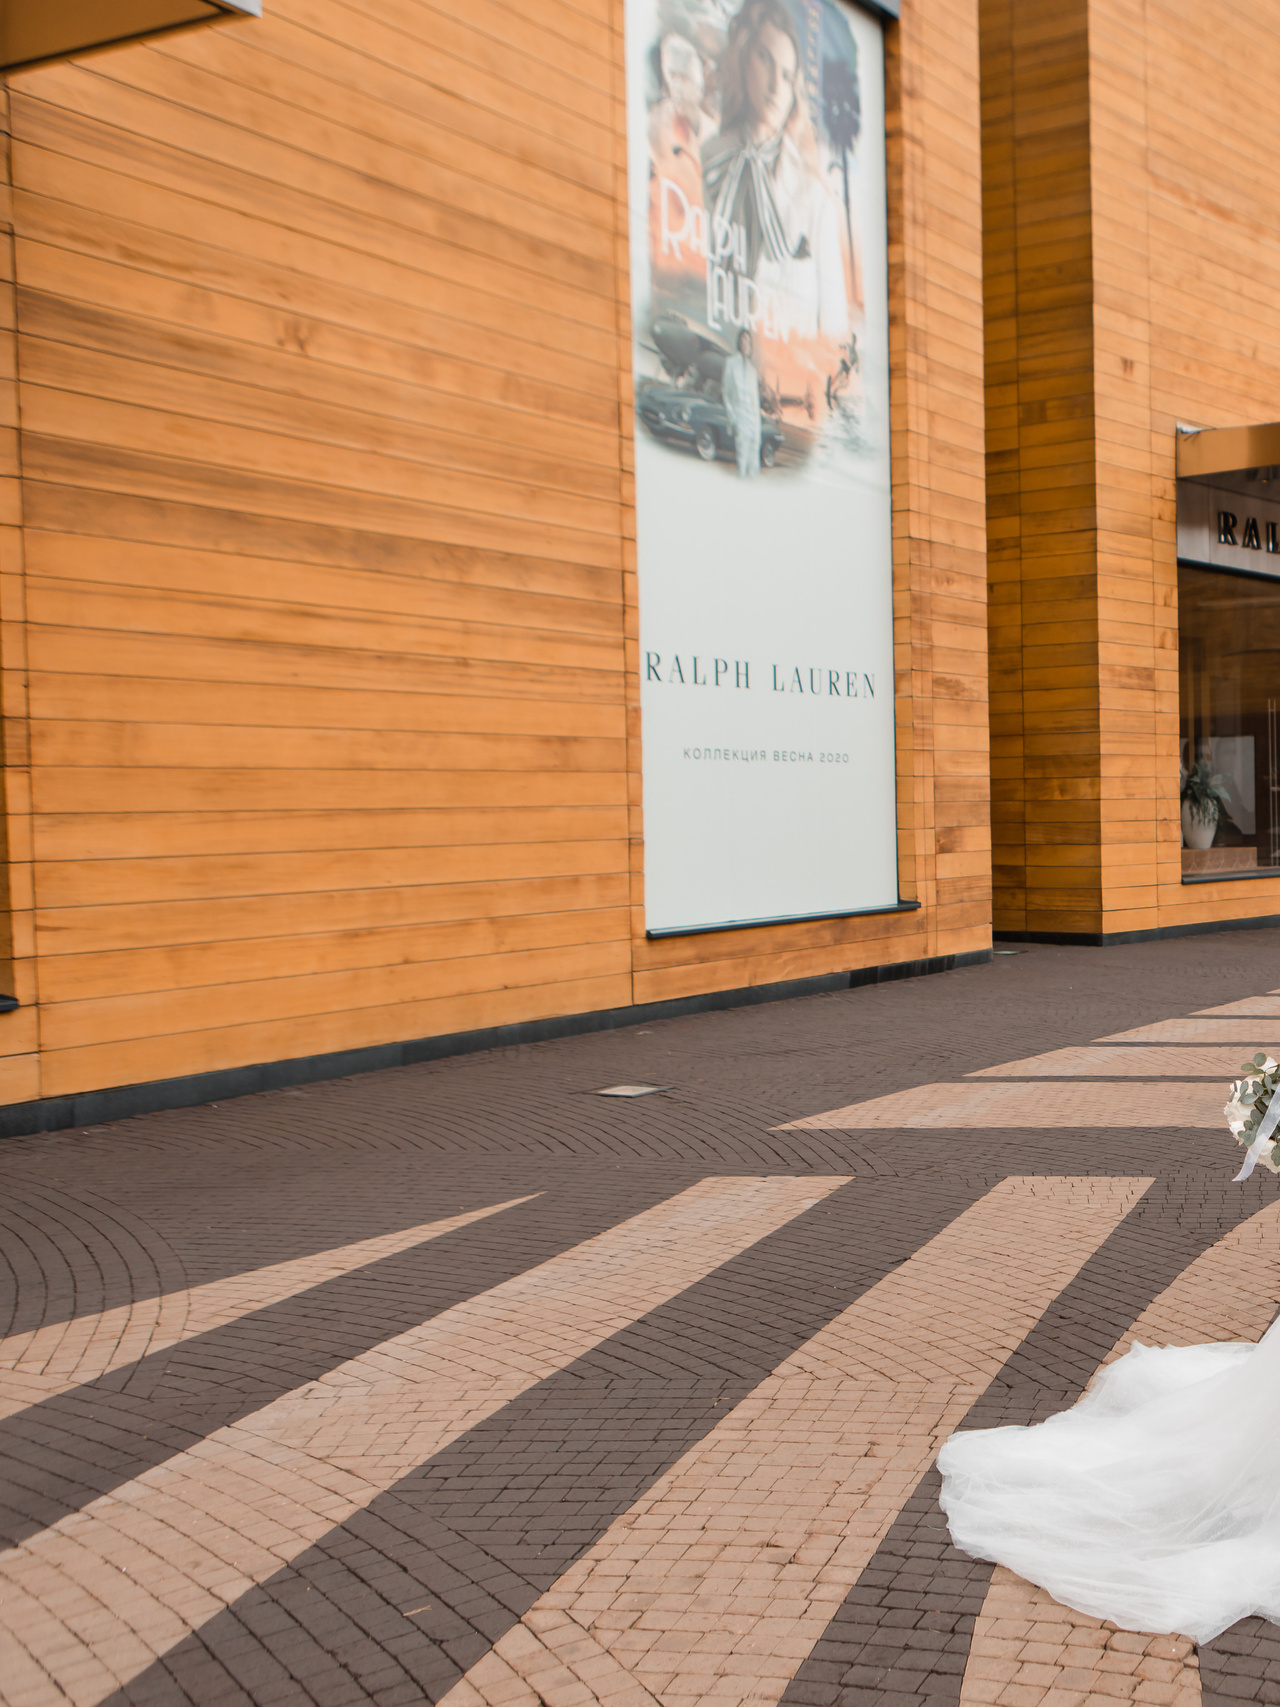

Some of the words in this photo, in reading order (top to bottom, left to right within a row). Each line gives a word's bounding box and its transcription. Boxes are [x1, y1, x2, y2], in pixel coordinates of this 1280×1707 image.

[645, 651, 751, 689] RALPH
[772, 664, 876, 698] LAUREN
[683, 747, 767, 762] КОЛЛЕКЦИЯ
[773, 750, 813, 763] ВЕСНА
[819, 752, 849, 763] 2020
